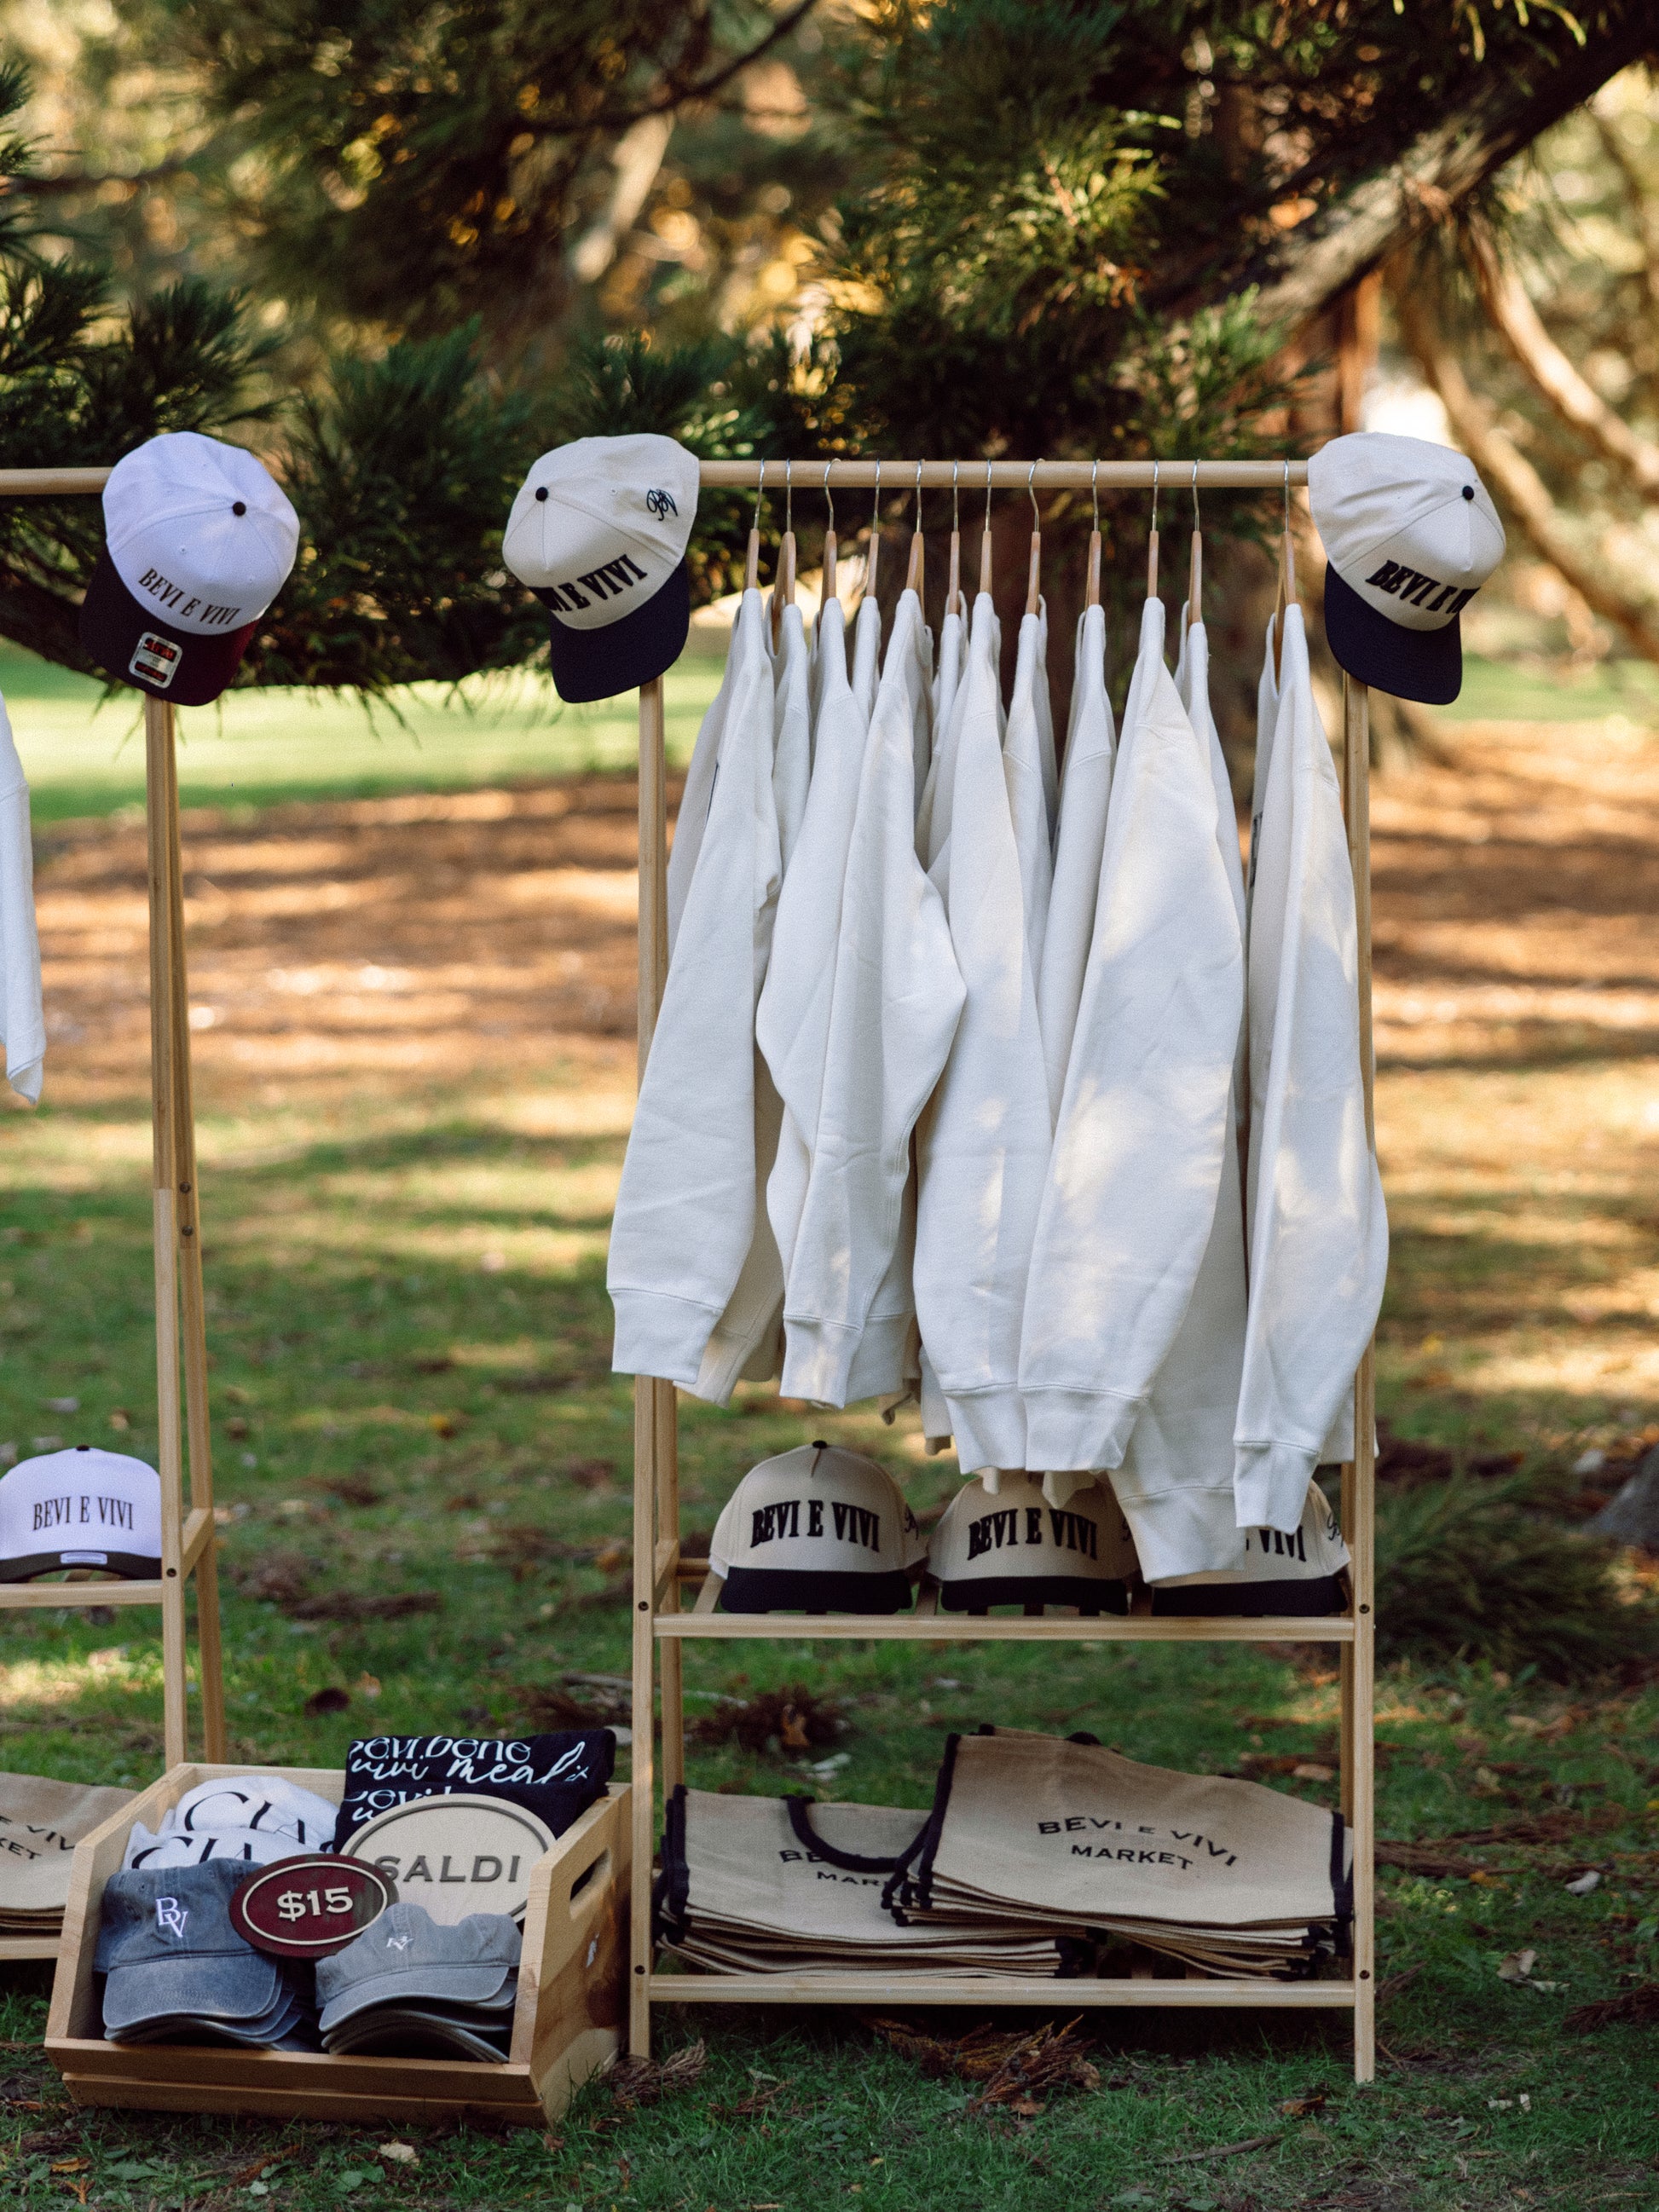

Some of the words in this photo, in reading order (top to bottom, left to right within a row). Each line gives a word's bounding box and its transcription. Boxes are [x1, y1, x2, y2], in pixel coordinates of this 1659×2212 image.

[138, 568, 185, 609] BEVI
[181, 598, 201, 616] E
[199, 604, 242, 625] VIVI
[558, 582, 591, 609] E
[577, 554, 648, 600] VIVI
[1365, 559, 1441, 606] BEVI
[1425, 585, 1458, 611] E
[32, 1496, 72, 1531] BEVI
[79, 1495, 90, 1522] E
[97, 1496, 135, 1531] VIVI
[750, 1499, 801, 1548] BEVI
[806, 1499, 824, 1537] E
[831, 1501, 880, 1552] VIVI
[967, 1508, 1019, 1561] BEVI
[1025, 1507, 1042, 1544] E
[1049, 1508, 1097, 1561] VIVI
[425, 1735, 531, 1764] bene
[26, 1824, 76, 1851] VIV
[1038, 1816, 1122, 1834] BEVI
[1171, 1829, 1237, 1867] VIVI
[373, 1854, 521, 1883] SALDI
[779, 1849, 824, 1863] BE
[1071, 1844, 1194, 1870] MARKET
[817, 1870, 882, 1886] MAR
[276, 1886, 354, 1922] $15
